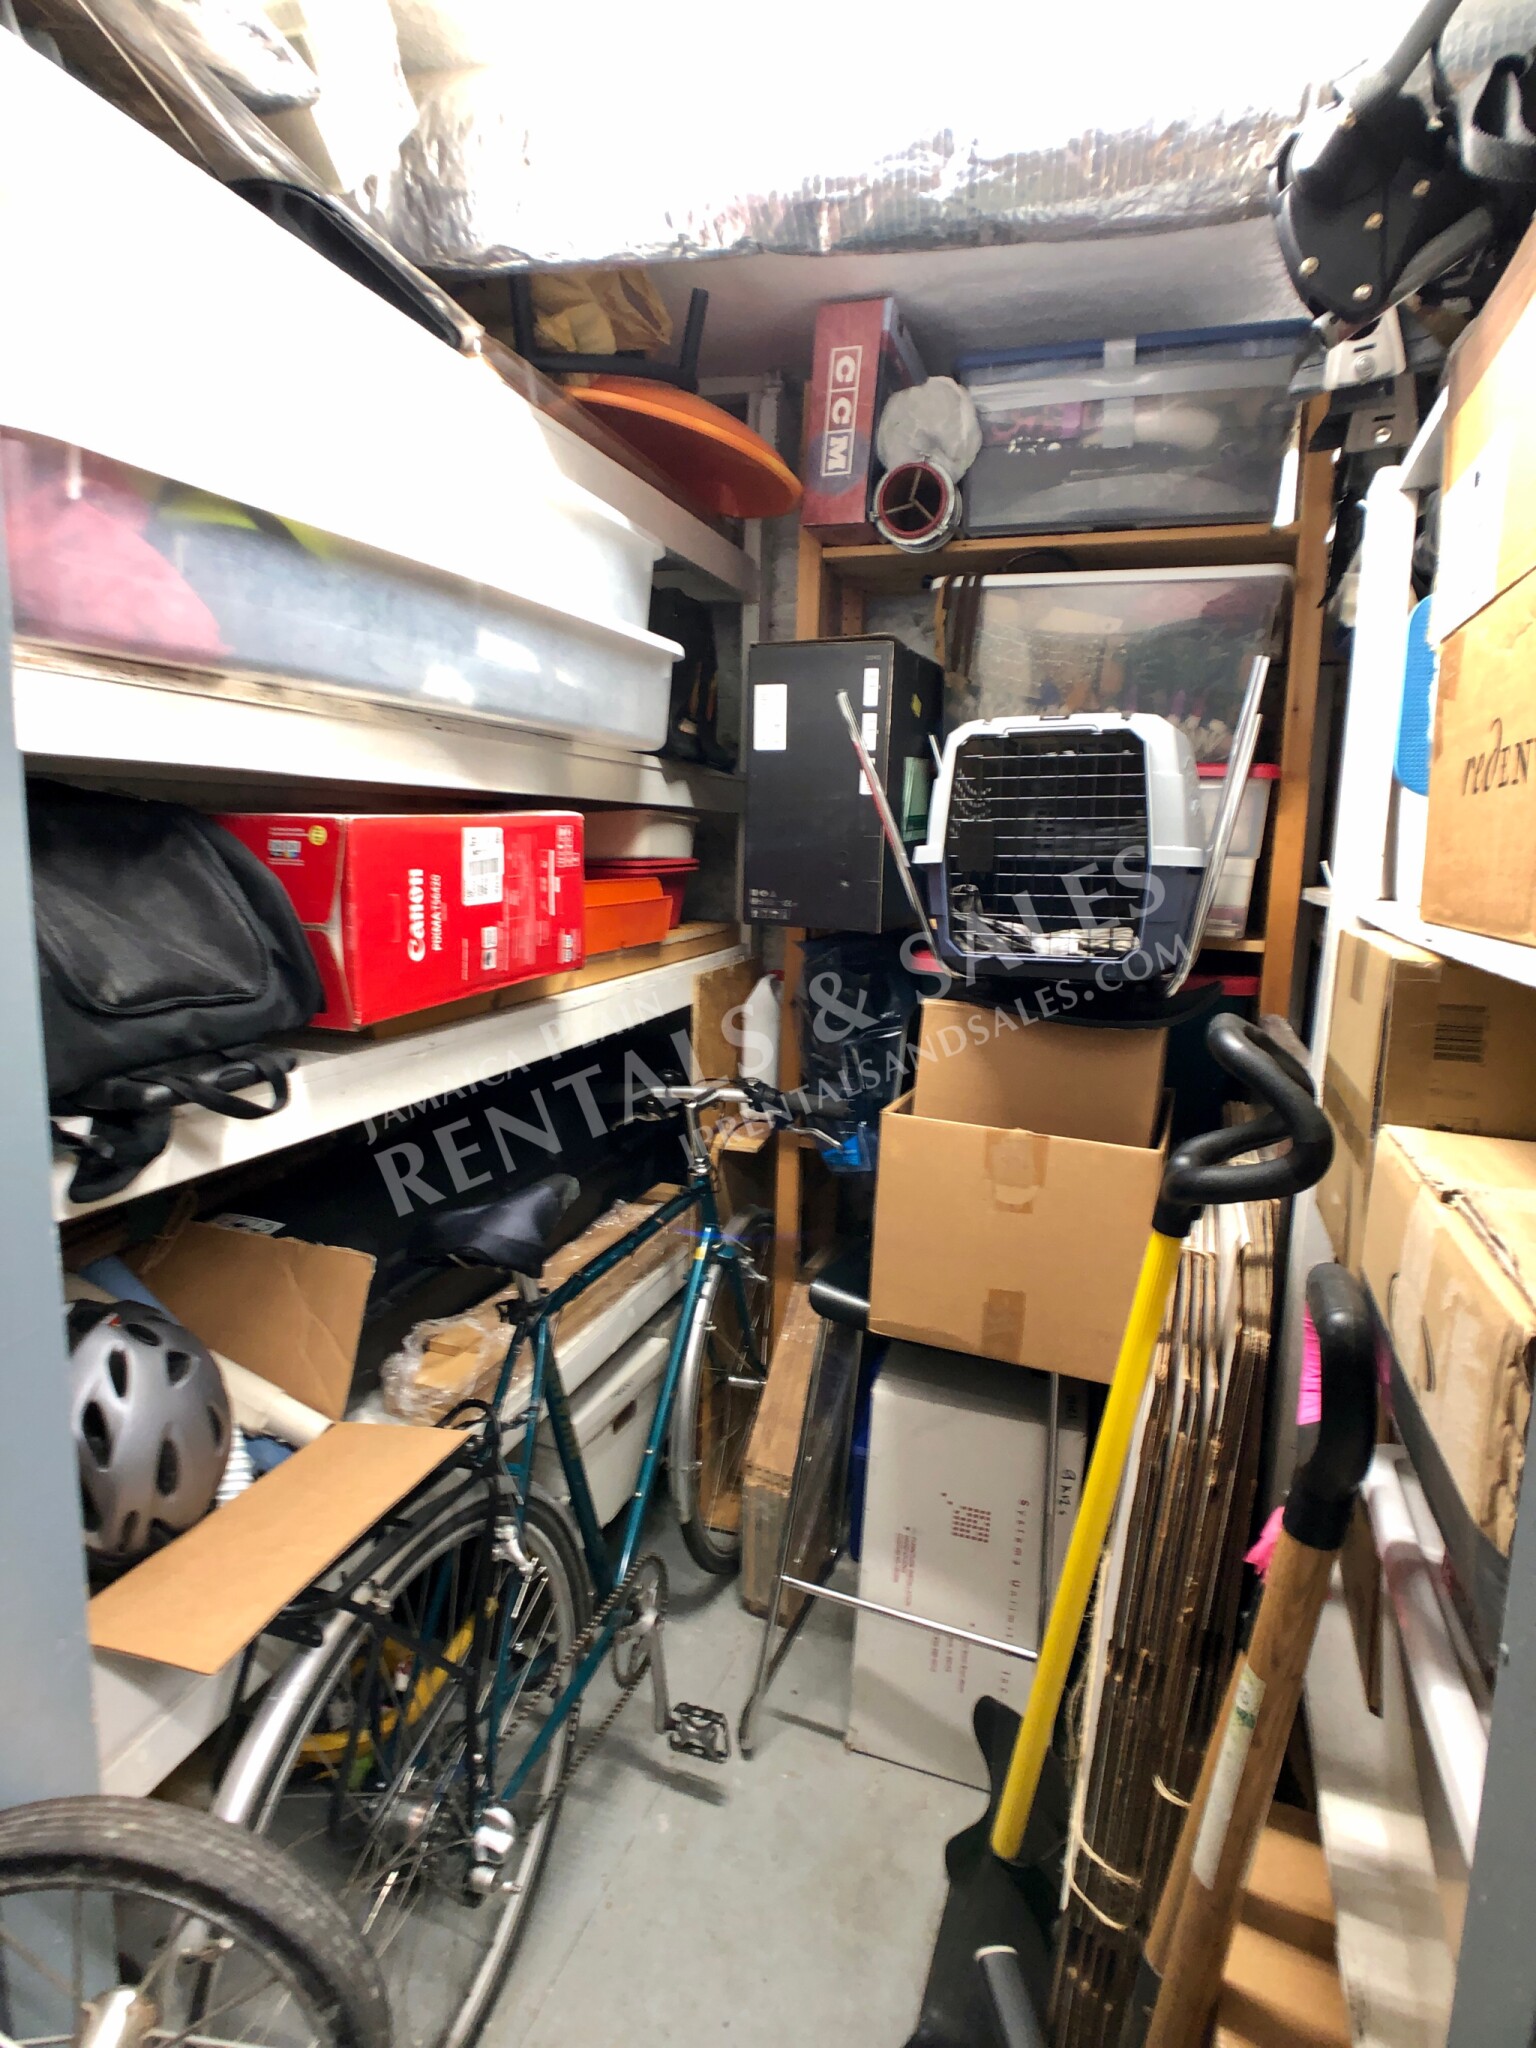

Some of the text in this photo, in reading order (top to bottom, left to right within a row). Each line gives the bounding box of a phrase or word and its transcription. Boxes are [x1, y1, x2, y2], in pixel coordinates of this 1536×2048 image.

[825, 352, 858, 473] CCM
[408, 869, 425, 962] Canon
[431, 911, 443, 951] PIXMA
